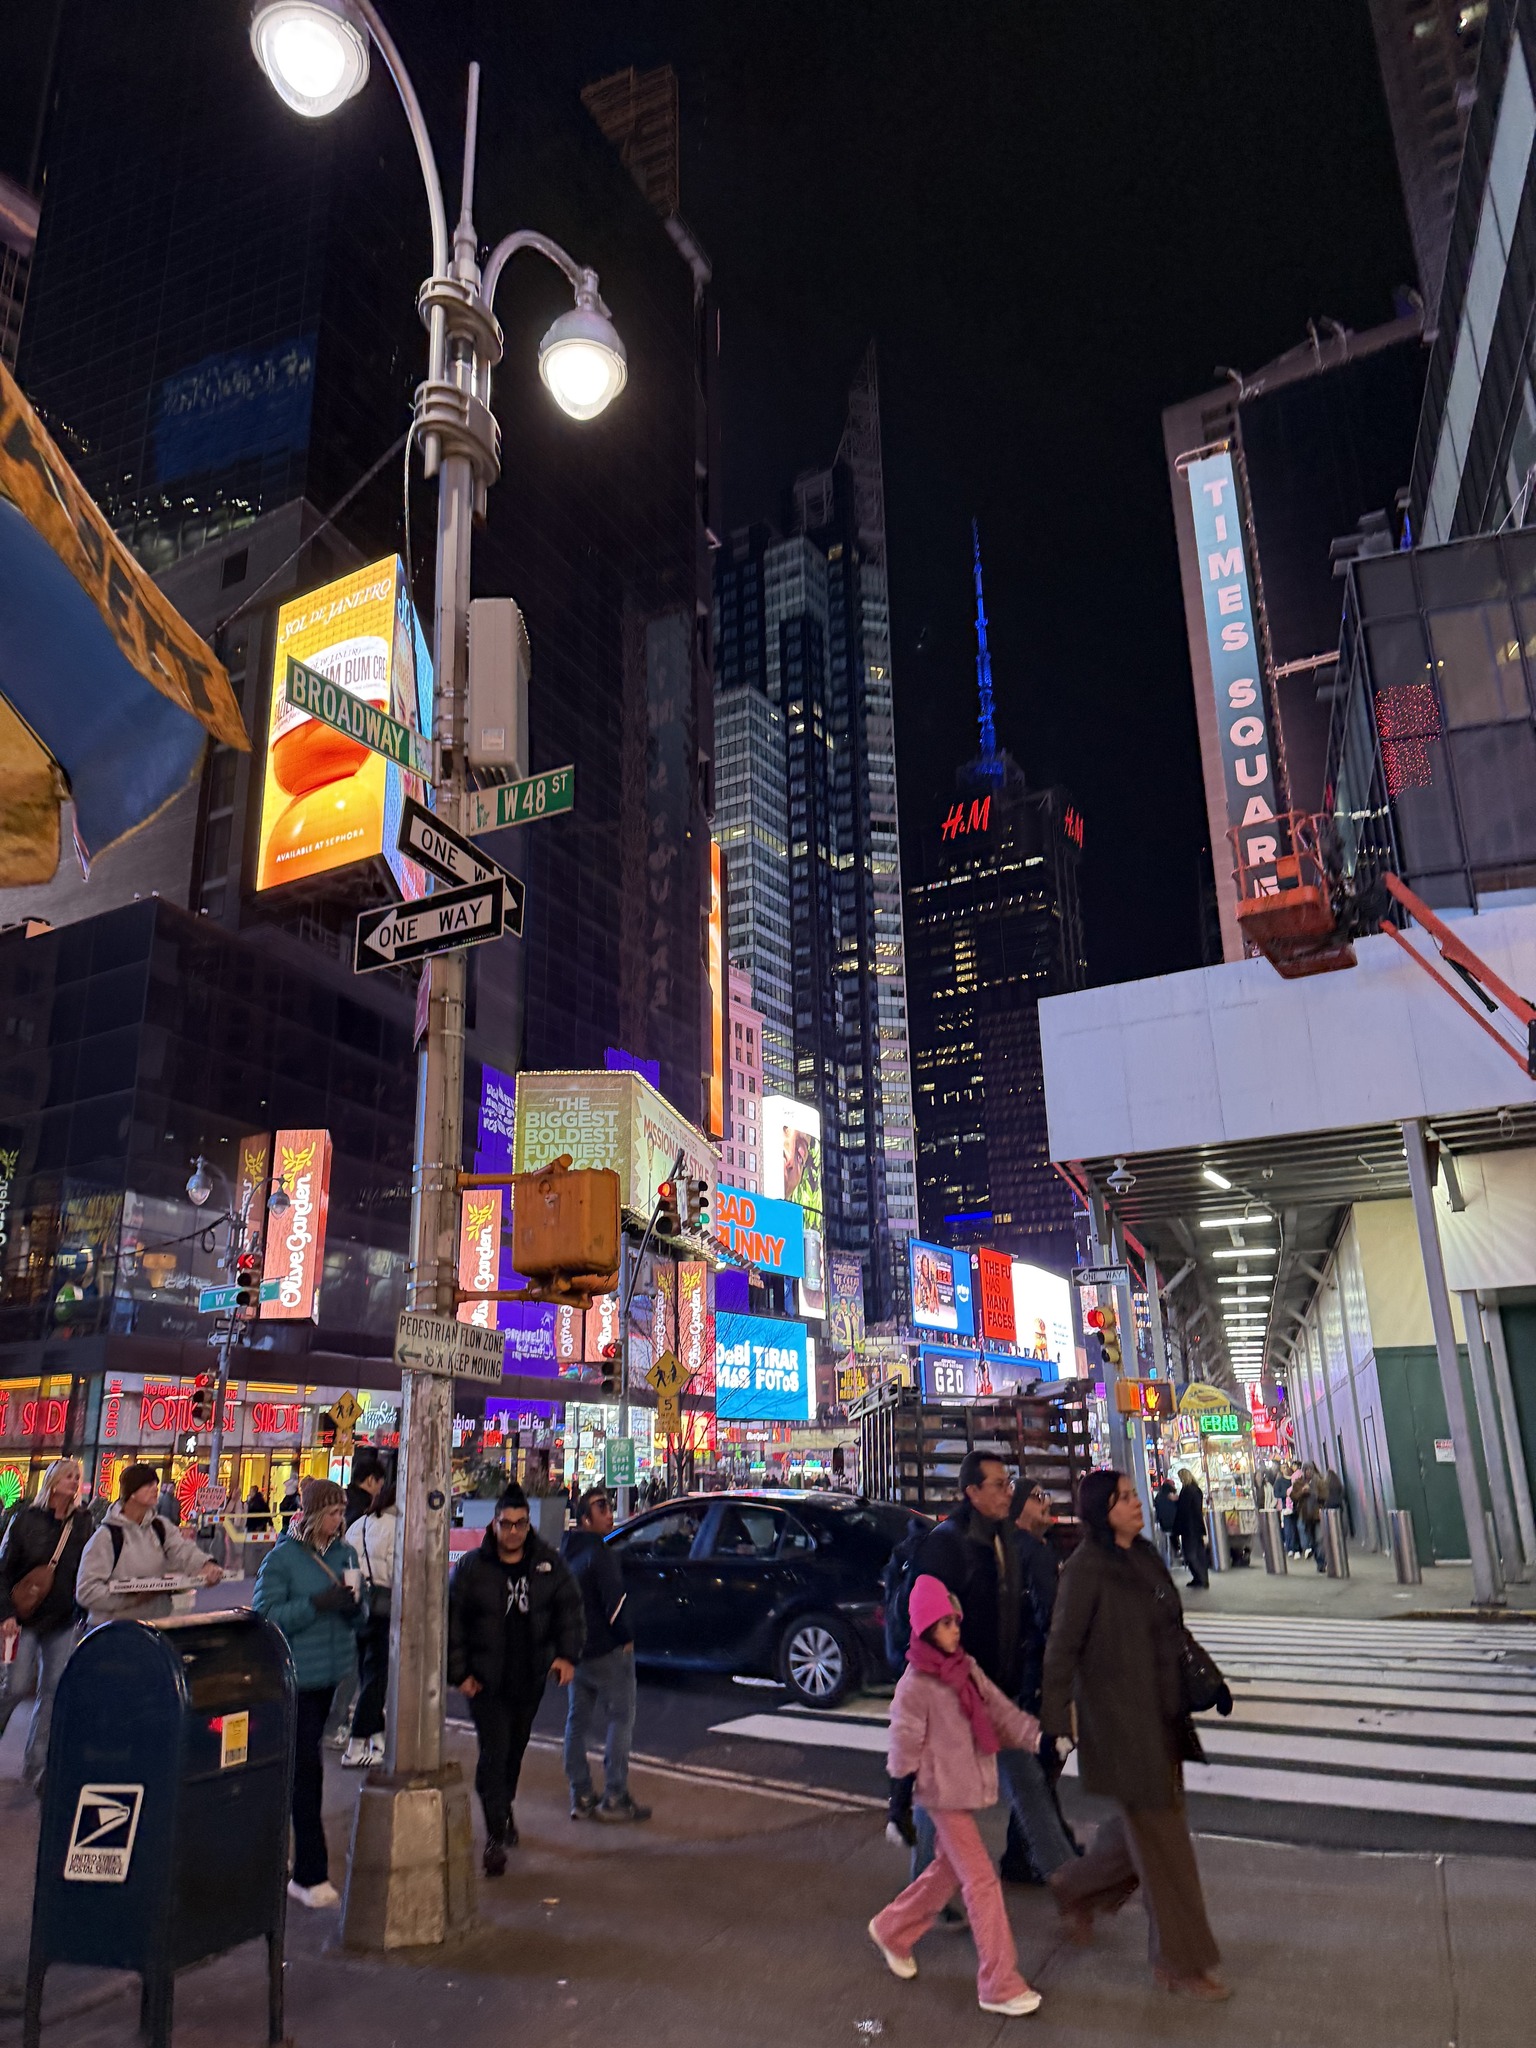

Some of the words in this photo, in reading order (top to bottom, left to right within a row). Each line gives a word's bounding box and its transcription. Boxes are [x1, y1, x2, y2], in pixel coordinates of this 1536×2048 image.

[281, 615, 308, 643] SOL
[324, 578, 391, 626] JANEIRO
[345, 656, 371, 686] BUM
[373, 655, 387, 681] CRE
[1204, 477, 1249, 652] TIMES
[1228, 678, 1281, 896] SQUARE
[291, 665, 405, 759] BROADWAY
[504, 786, 519, 822] W
[522, 780, 547, 815] 48
[552, 773, 568, 794] ST
[942, 795, 990, 842] H&M
[1064, 803, 1084, 849] H&M
[276, 843, 313, 863] AVAILABLE
[315, 841, 324, 852] AT
[326, 828, 365, 848] SEPHORA
[421, 828, 459, 871] ONE
[379, 918, 419, 948] ONE
[439, 901, 483, 932] WAY
[525, 1143, 618, 1159] FUNNIEST
[716, 1191, 756, 1228] BAD
[716, 1224, 785, 1267] BUNNY
[984, 1258, 1000, 1277] THE
[1105, 1270, 1123, 1279] WAY
[215, 1293, 226, 1306] W
[985, 1277, 1001, 1294] HAS
[986, 1294, 1010, 1313] MANY
[399, 1315, 459, 1345] PEDESTRIAN
[460, 1327, 482, 1348] FLOW
[483, 1333, 504, 1354] ZONE
[448, 1349, 470, 1374] KEEP
[471, 1356, 502, 1380] MOVING
[934, 1367, 964, 1394] G20
[158, 1384, 192, 1398] fantatic
[664, 1399, 673, 1411] 5
[139, 1397, 236, 1433] PORTUGUSE
